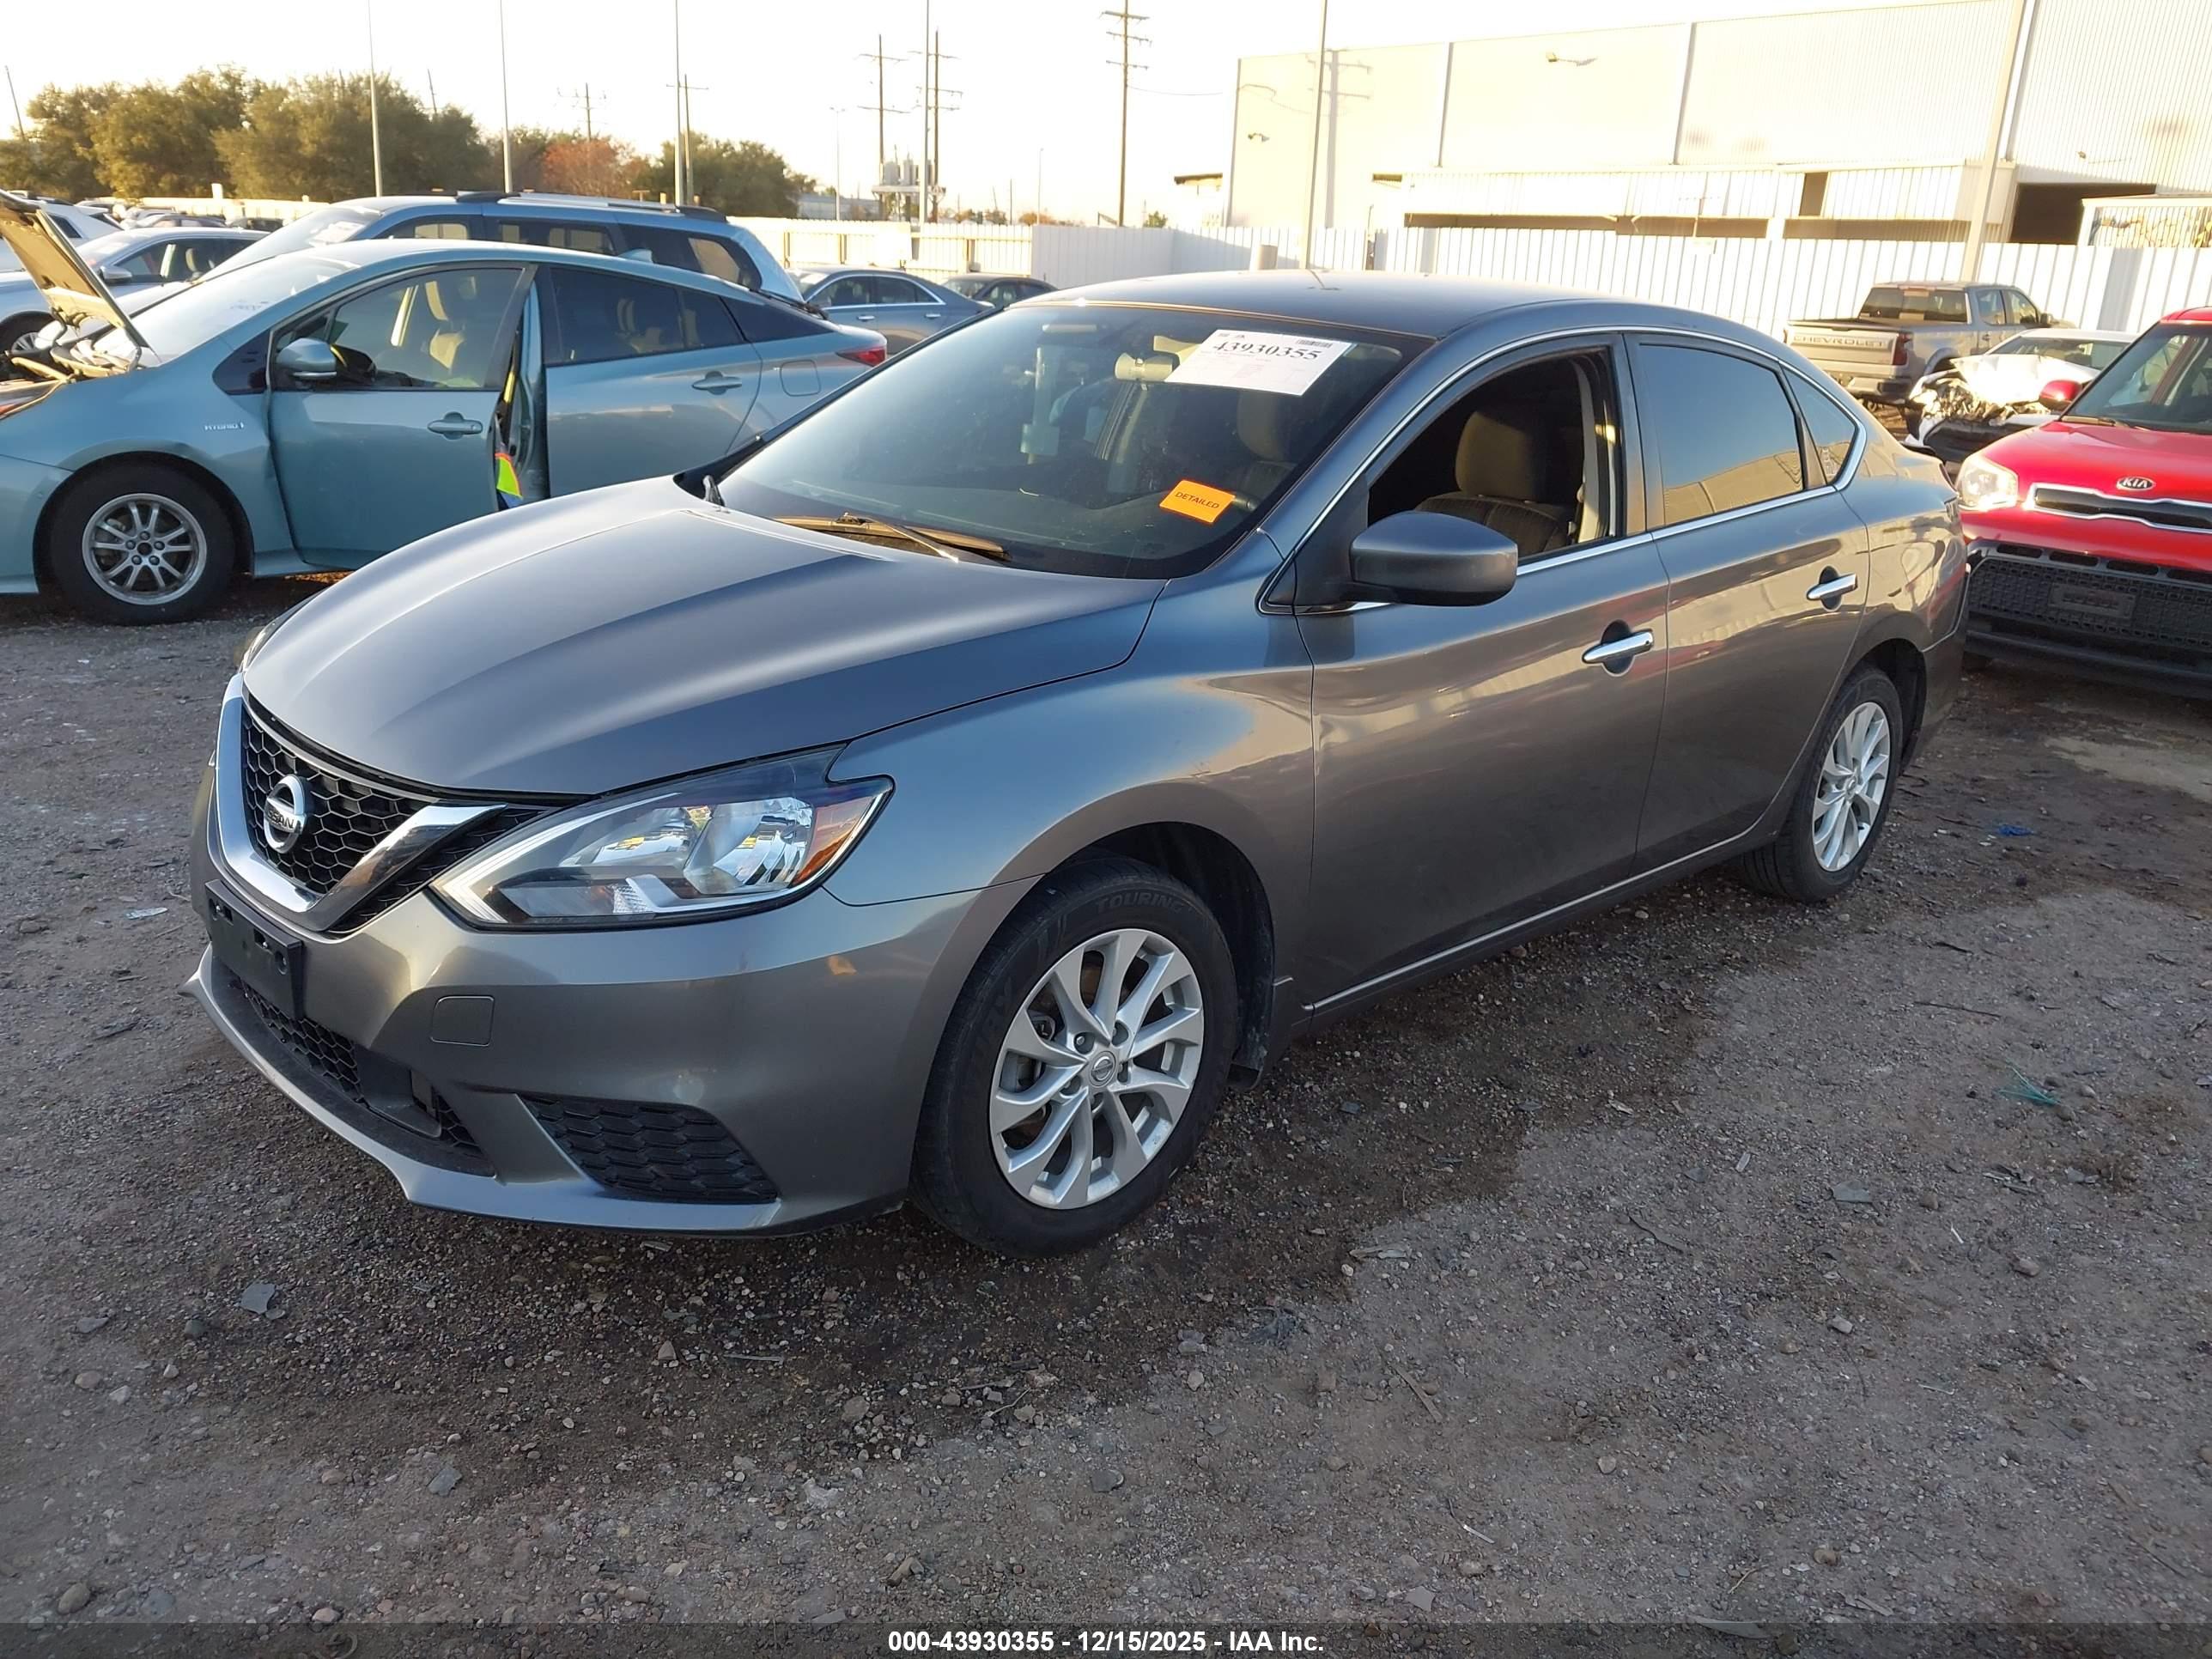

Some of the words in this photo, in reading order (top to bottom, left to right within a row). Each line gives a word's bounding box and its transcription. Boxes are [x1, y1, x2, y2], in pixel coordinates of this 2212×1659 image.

[1793, 336, 1887, 348] CHEVROLET
[1213, 341, 1322, 360] 43930355
[2122, 477, 2148, 489] KIA
[1175, 491, 1220, 508] DETAILED
